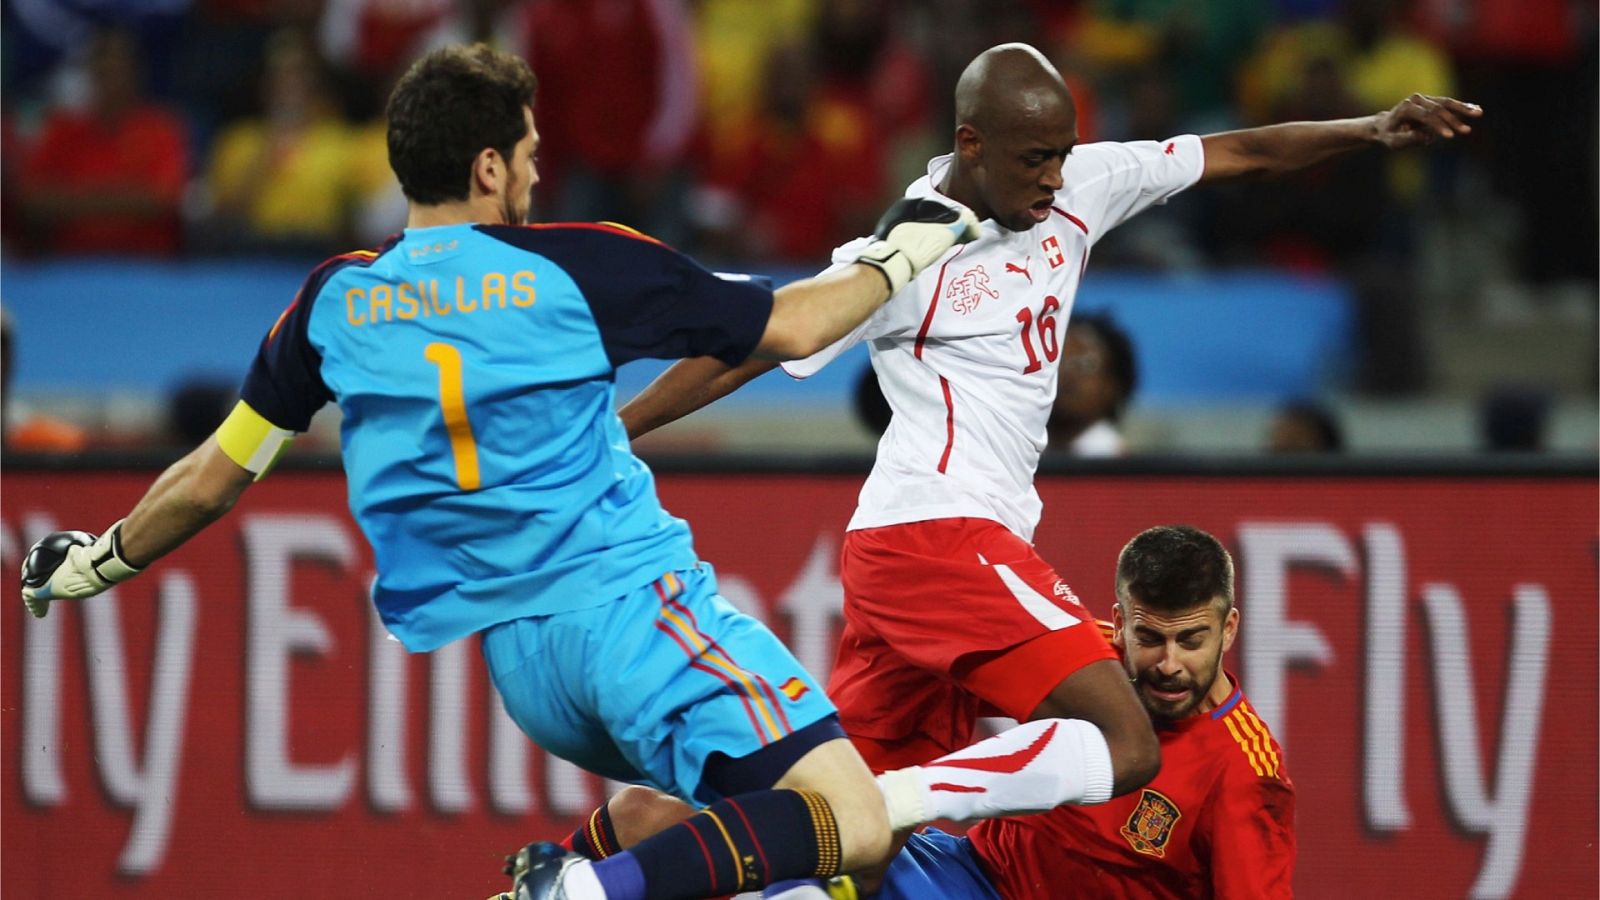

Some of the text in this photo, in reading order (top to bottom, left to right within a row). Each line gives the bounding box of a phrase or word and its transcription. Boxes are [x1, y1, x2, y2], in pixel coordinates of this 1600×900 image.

[346, 270, 536, 326] CASILLAS
[1016, 295, 1060, 375] 16
[424, 341, 481, 491] 1
[0, 512, 197, 875] ly
[1236, 520, 1554, 900] Fly
